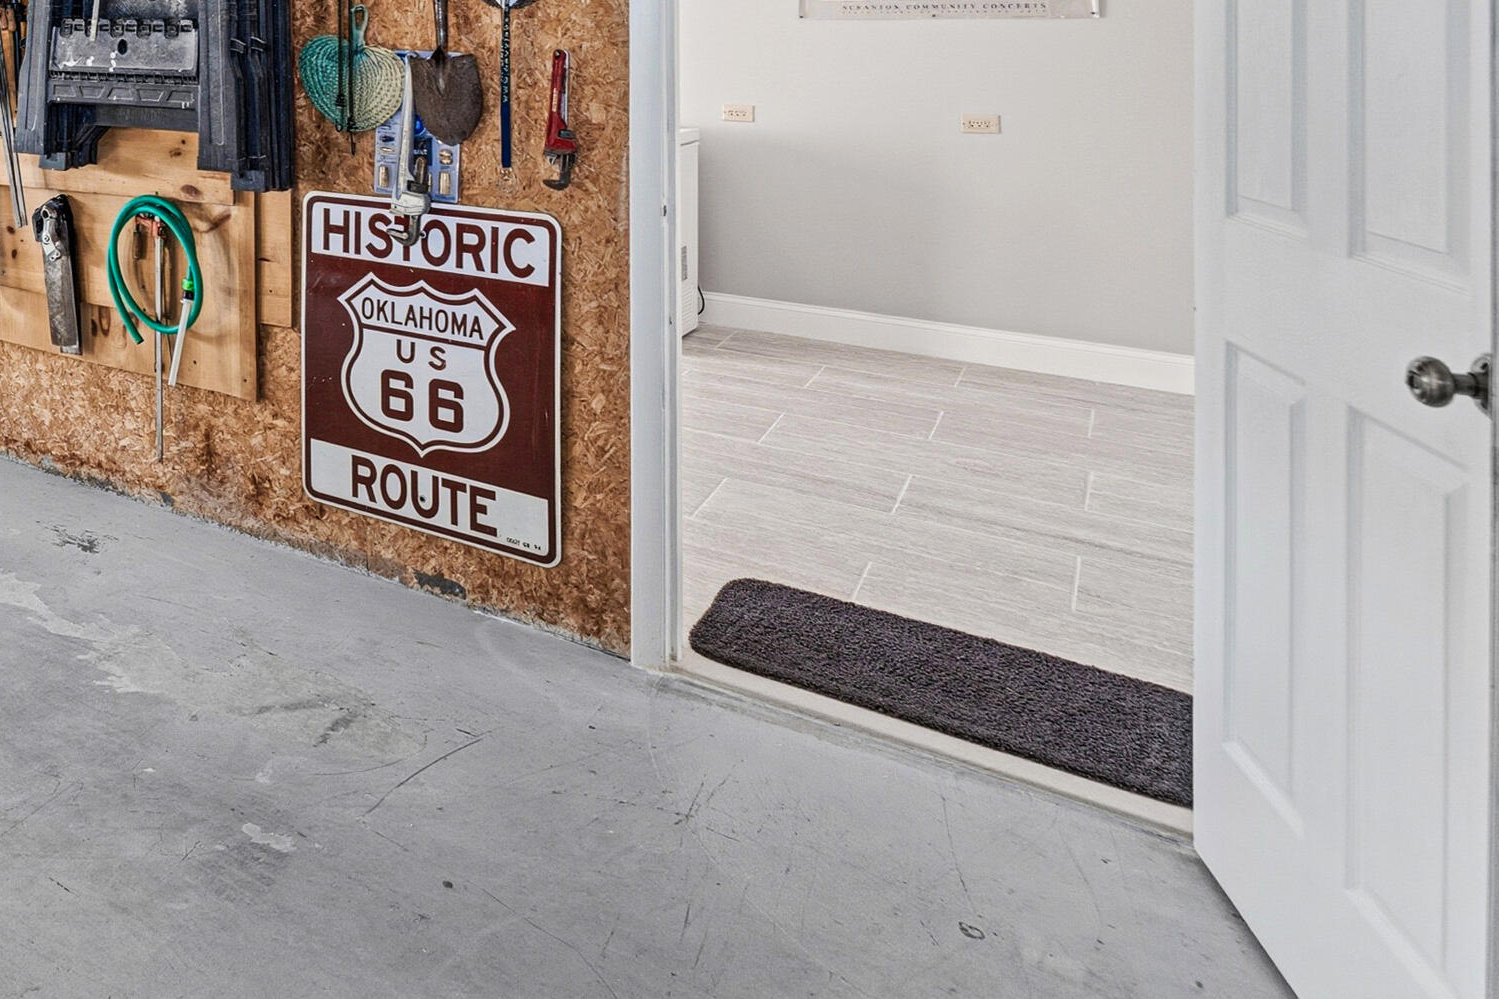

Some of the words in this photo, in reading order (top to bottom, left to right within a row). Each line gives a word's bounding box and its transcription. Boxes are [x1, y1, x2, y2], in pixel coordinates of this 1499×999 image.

[322, 208, 535, 278] HISTORIC
[361, 297, 484, 341] OKLAHOMA
[381, 369, 464, 433] 66
[351, 454, 498, 538] ROUTE
